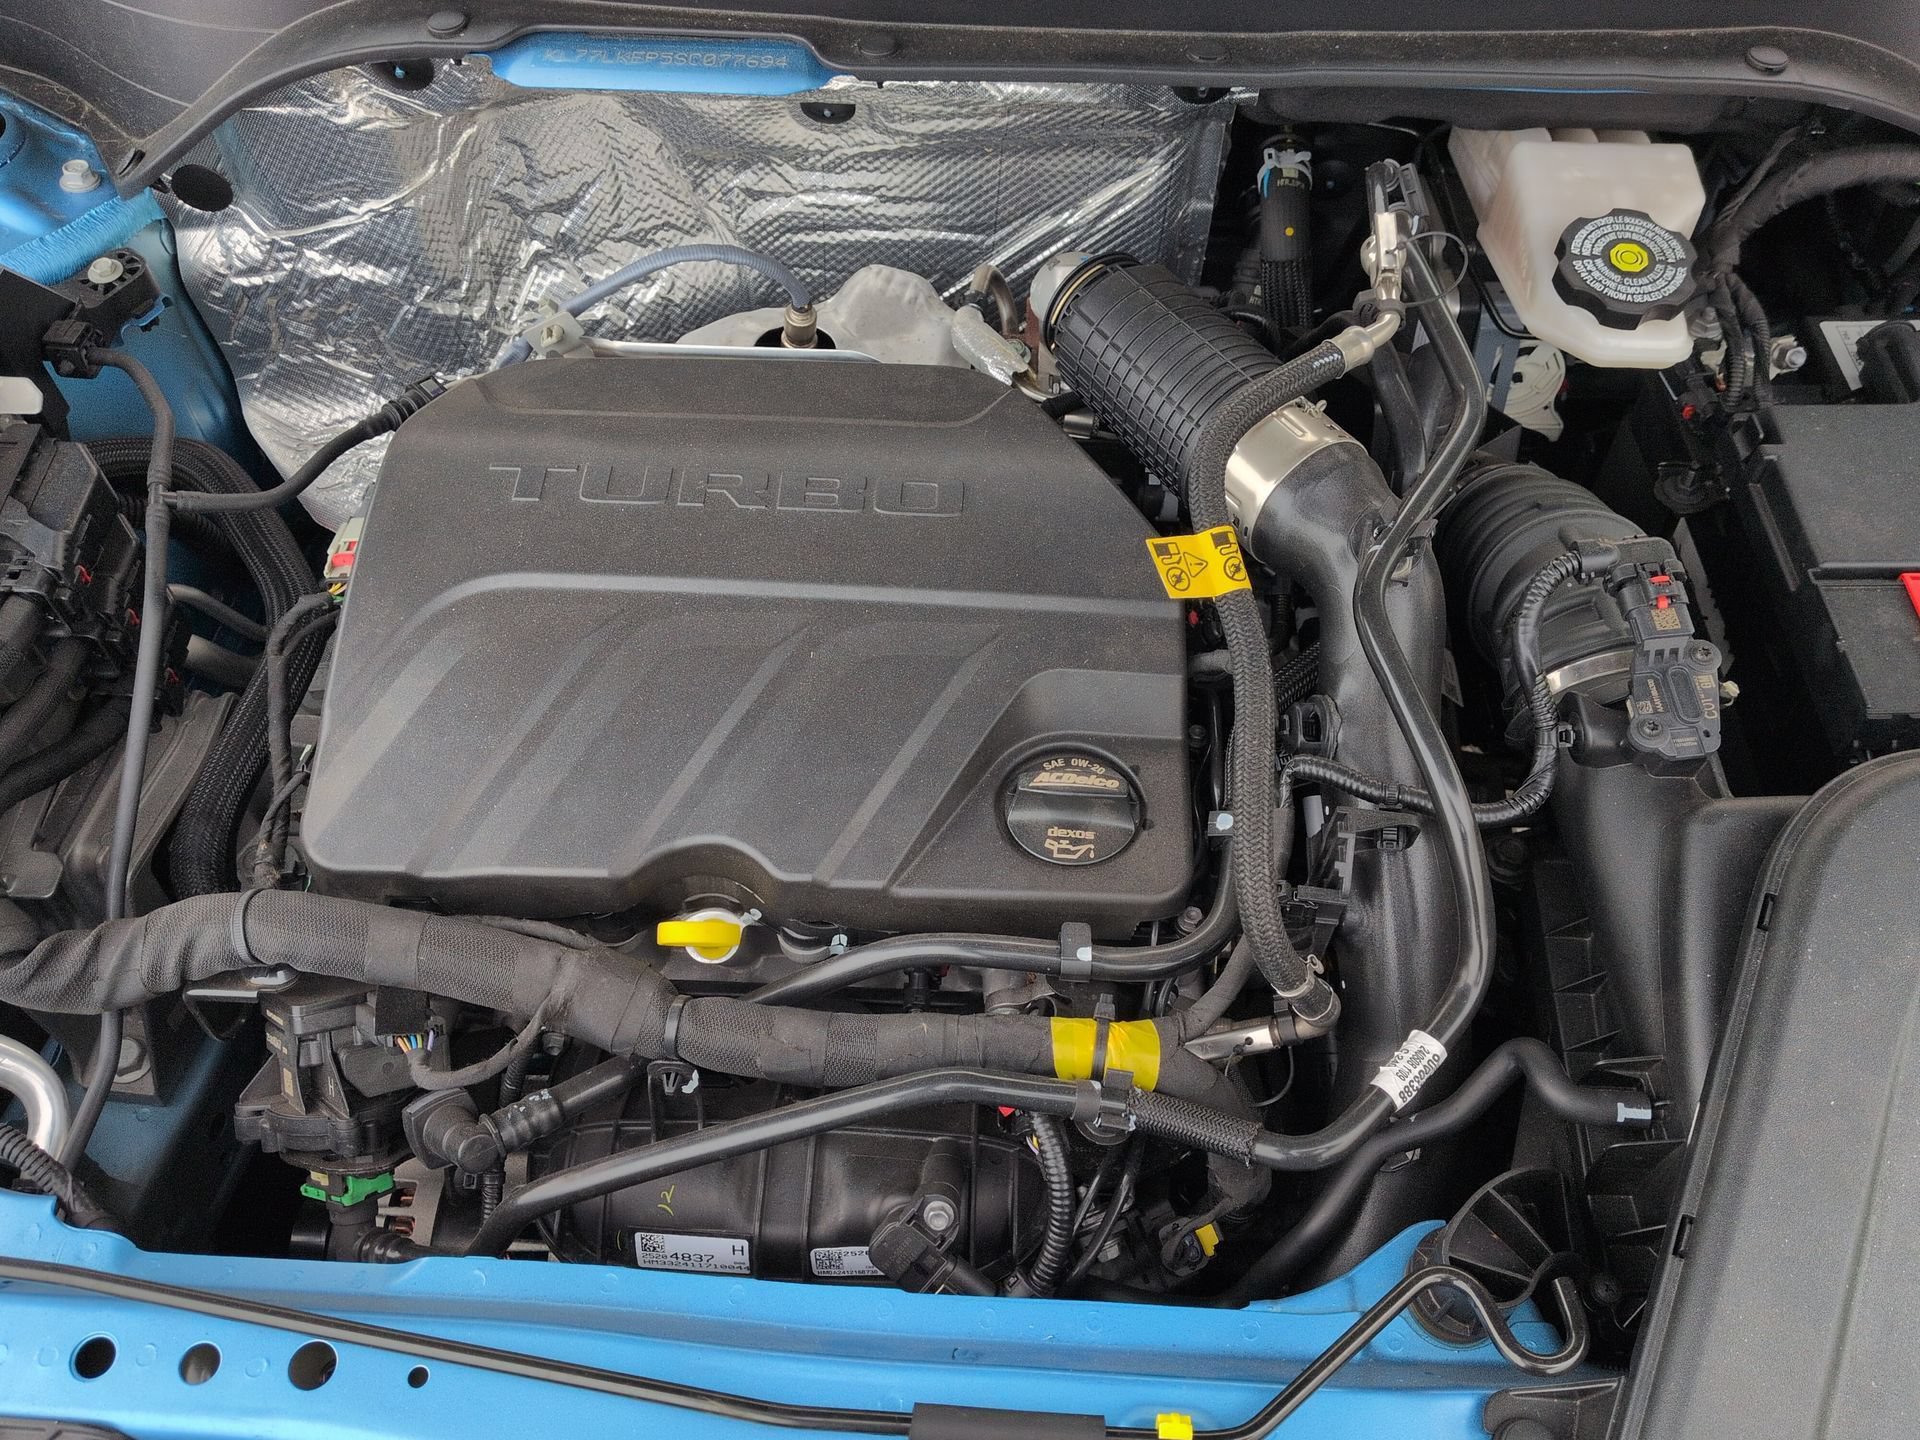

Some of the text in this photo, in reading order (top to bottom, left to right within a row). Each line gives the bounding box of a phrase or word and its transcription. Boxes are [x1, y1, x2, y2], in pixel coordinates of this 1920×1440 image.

[543, 49, 788, 69] KL77LKEP5SC077694
[1583, 259, 1597, 271] CAP
[1591, 270, 1617, 290] BEFORE
[1583, 275, 1604, 291] FLUID
[1603, 287, 1627, 300] FROM
[1626, 294, 1633, 302] A
[1633, 291, 1663, 302] SEALED
[489, 463, 965, 517] TURBO
[1043, 758, 1106, 775] SAE 0W-20
[1033, 772, 1120, 788] ACDelco
[1047, 826, 1096, 840] dexos
[670, 1252, 714, 1262] 4837
[732, 1245, 744, 1256] H
